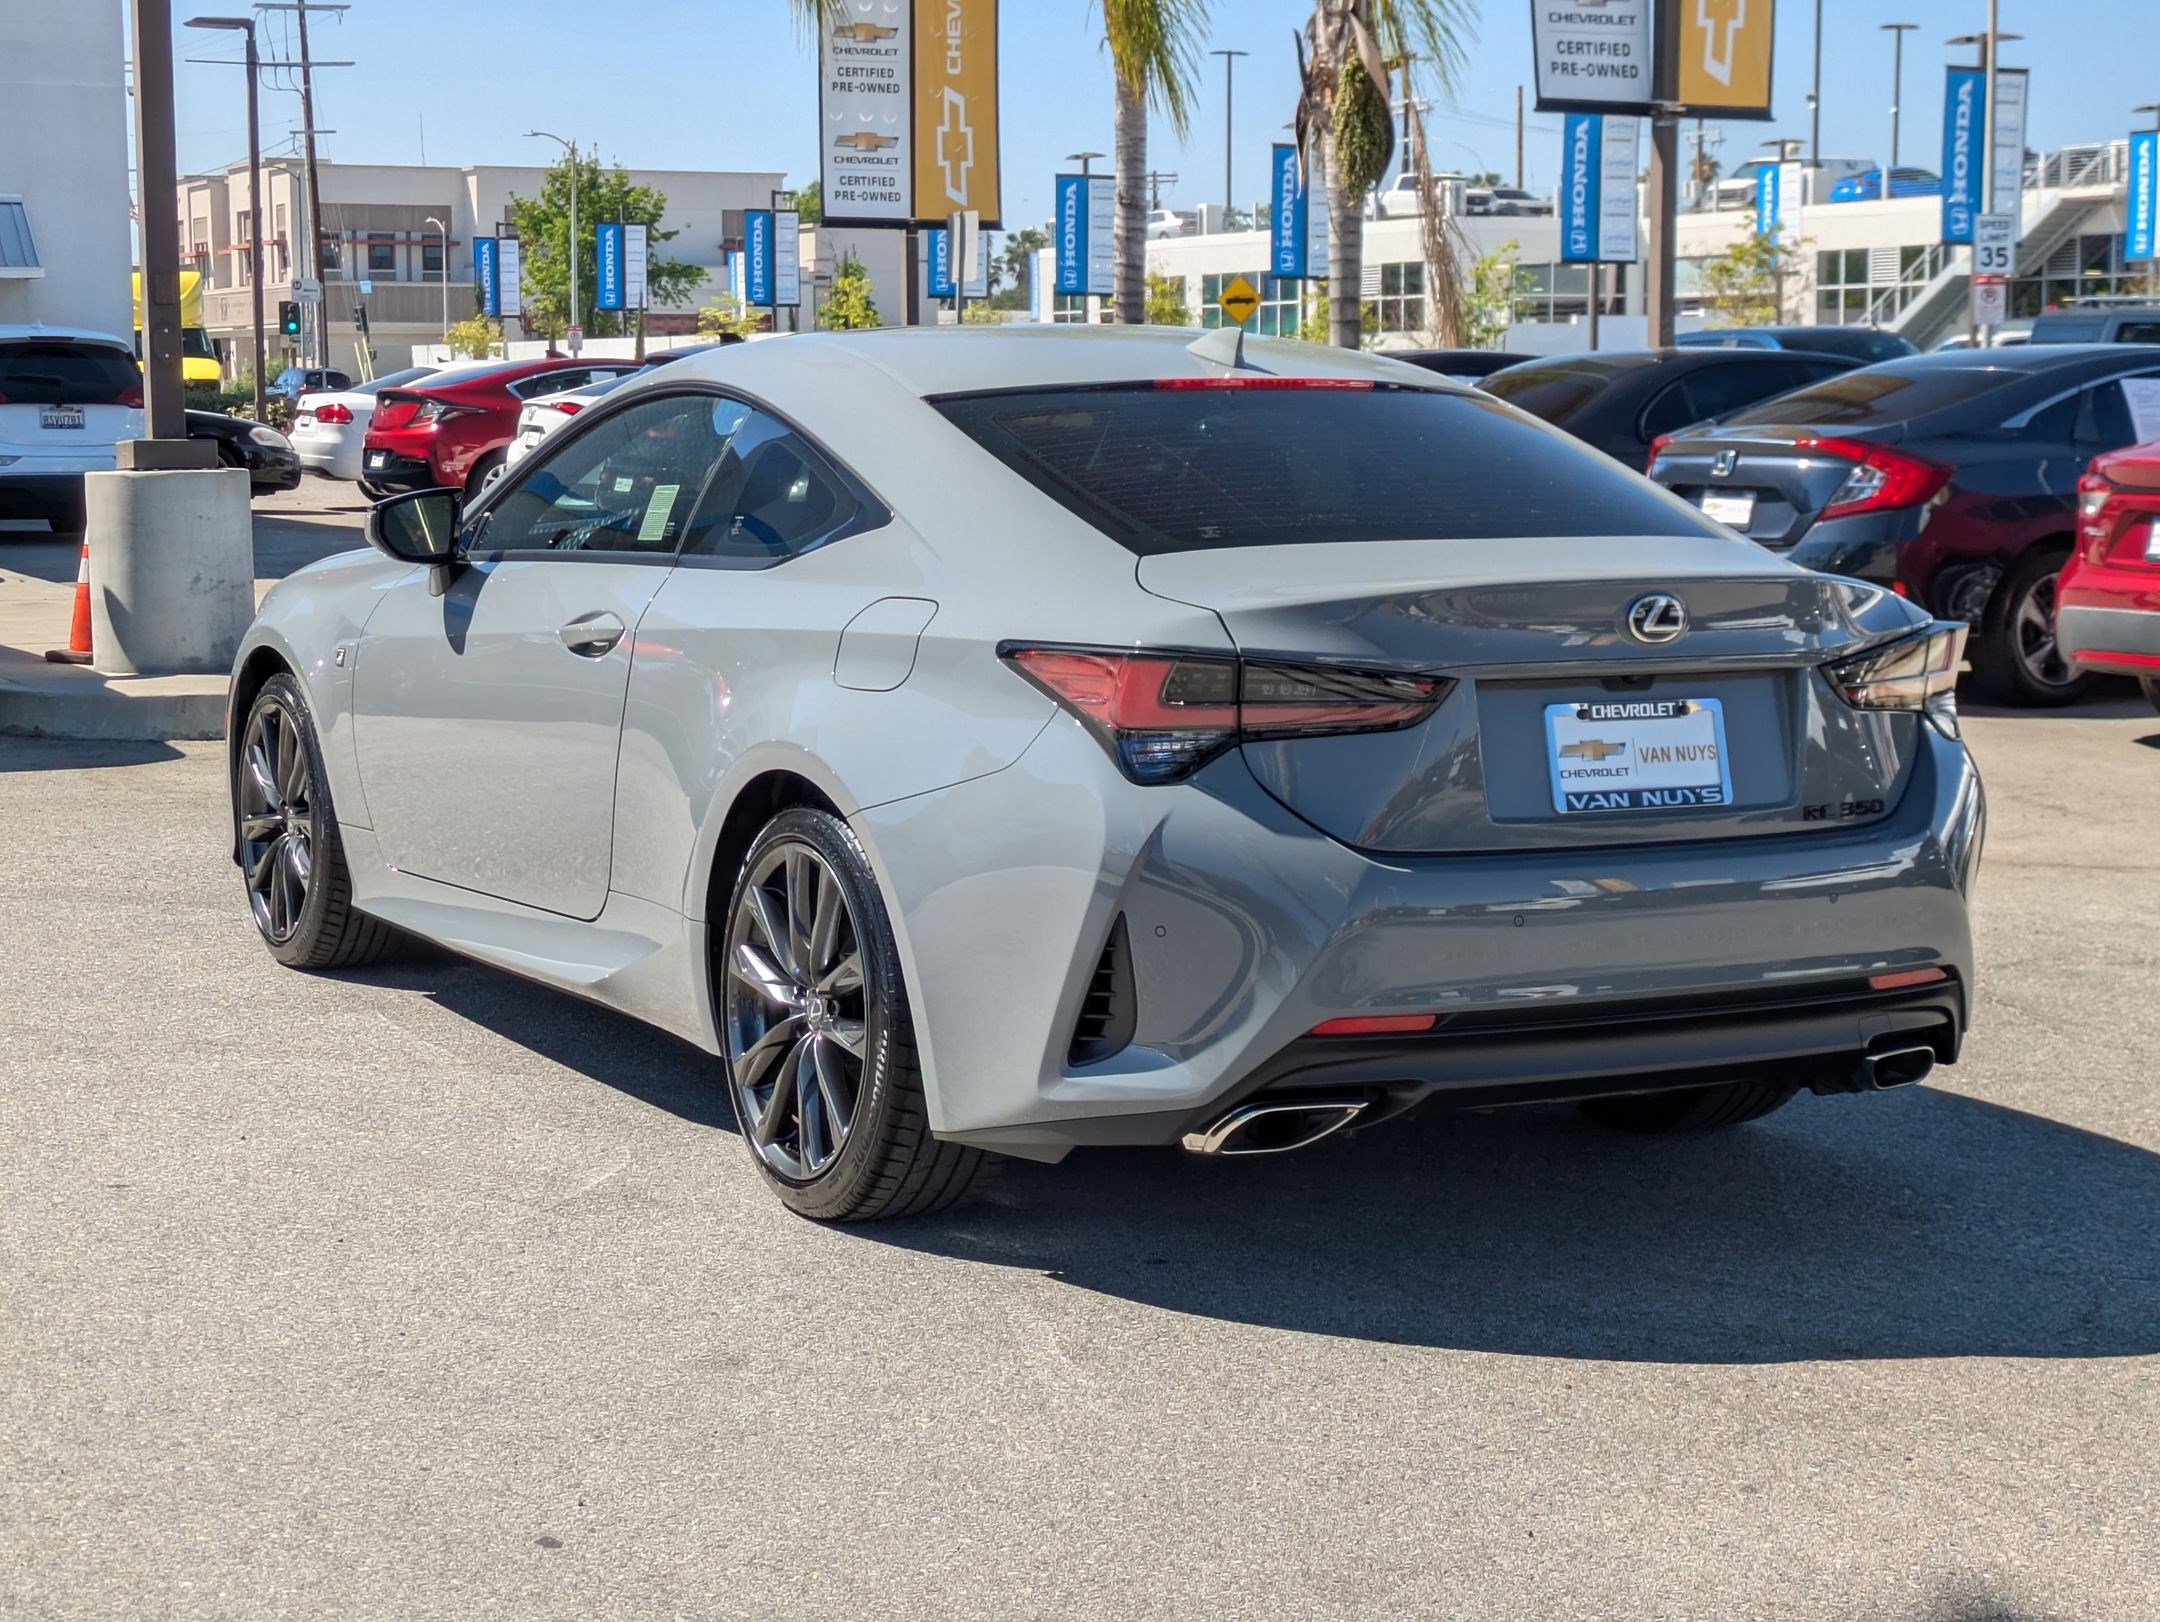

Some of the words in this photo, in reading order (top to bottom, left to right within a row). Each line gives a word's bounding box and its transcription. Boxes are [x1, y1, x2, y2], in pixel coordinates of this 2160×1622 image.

[1548, 12, 1637, 26] CHEVROLET
[832, 46, 899, 56] CHEVROLET
[1556, 40, 1631, 57] CERTIFIED
[837, 66, 894, 78] CERTIFIED
[1550, 61, 1639, 79] PRE-OWNED
[832, 82, 900, 94] PRE-OWNED
[1953, 78, 1974, 204] HONDA
[833, 155, 899, 165] CHEVROLET
[839, 175, 896, 187] CERTIFIED
[1572, 119, 1589, 227] HONDA
[2137, 139, 2150, 229] HONDA
[834, 191, 901, 202] PRE-OWNED
[1281, 153, 1296, 248] HONDA
[1064, 182, 1077, 267] HONDA
[1980, 220, 2009, 230] SPEED
[1980, 233, 2009, 242] LIMIT
[753, 216, 763, 284] HONDA
[1981, 246, 2009, 268] 35
[605, 228, 615, 290] HONDA
[1591, 702, 1675, 719] CHEVROLET
[1640, 748, 1671, 763] VAN
[1676, 744, 1717, 762] NUYS
[1560, 767, 1630, 779] CHEVROLET
[1567, 792, 1630, 810] VAN
[1642, 787, 1722, 806] NUYS
[1803, 804, 1836, 821] RC
[1840, 799, 1884, 817] 350
